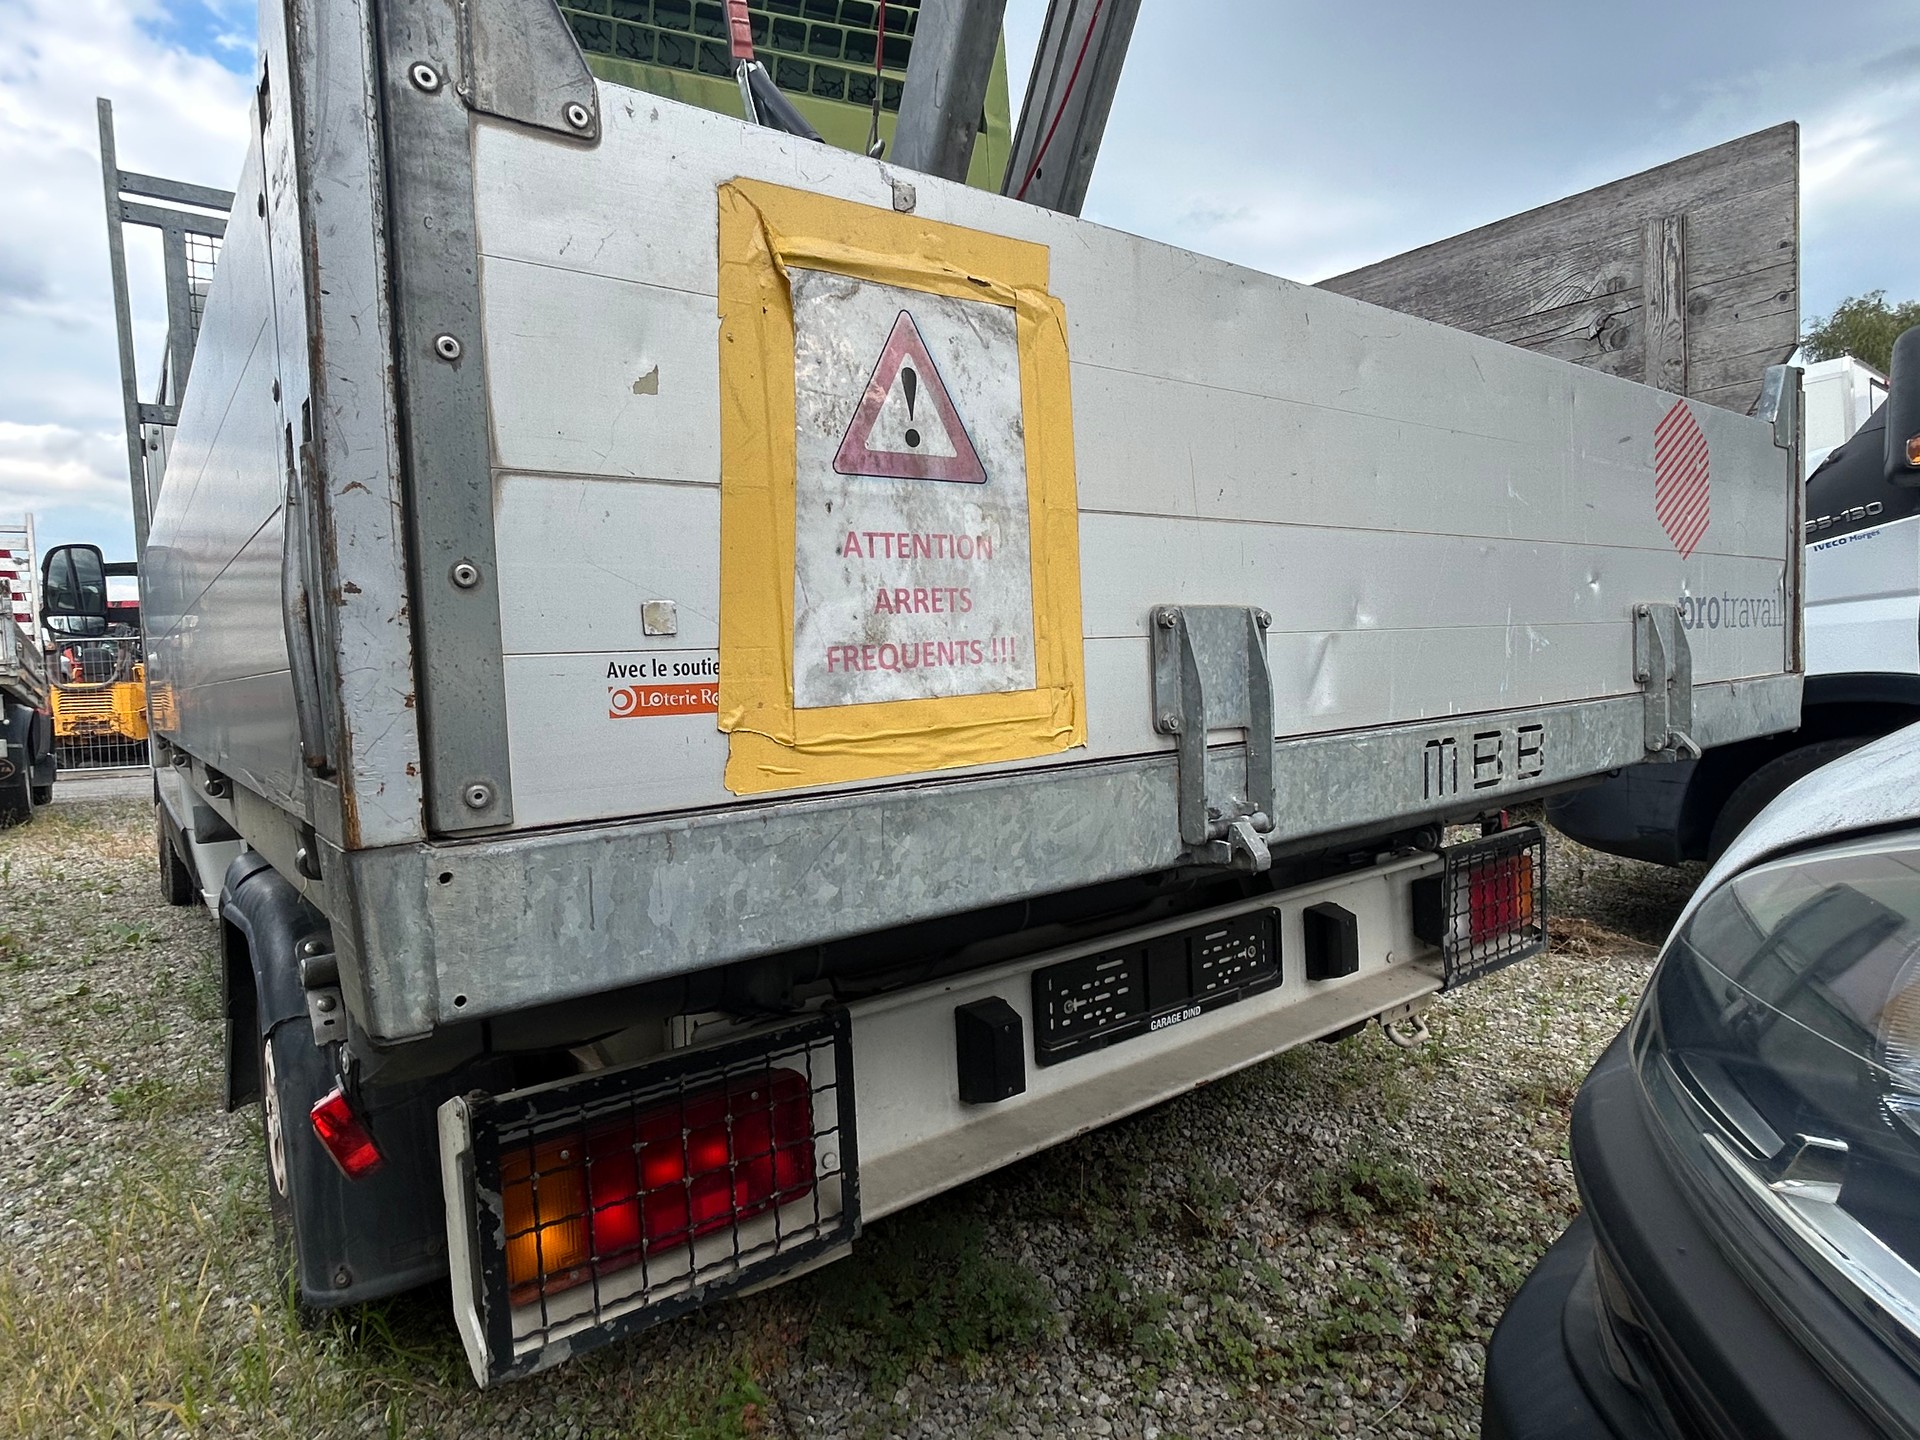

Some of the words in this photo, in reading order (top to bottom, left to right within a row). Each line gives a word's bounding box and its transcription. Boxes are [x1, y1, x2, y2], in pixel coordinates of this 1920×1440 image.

[843, 531, 993, 560] ATTENTION
[1813, 538, 1847, 552] IVECO
[1849, 529, 1881, 543] Morges
[874, 587, 973, 614] ARRETS
[607, 661, 647, 679] Avec
[652, 658, 667, 677] le
[673, 657, 720, 677] soutie
[826, 639, 983, 673] FREQUENTS
[1150, 1011, 1182, 1031] GARAGE
[1182, 1005, 1201, 1020] DIND
